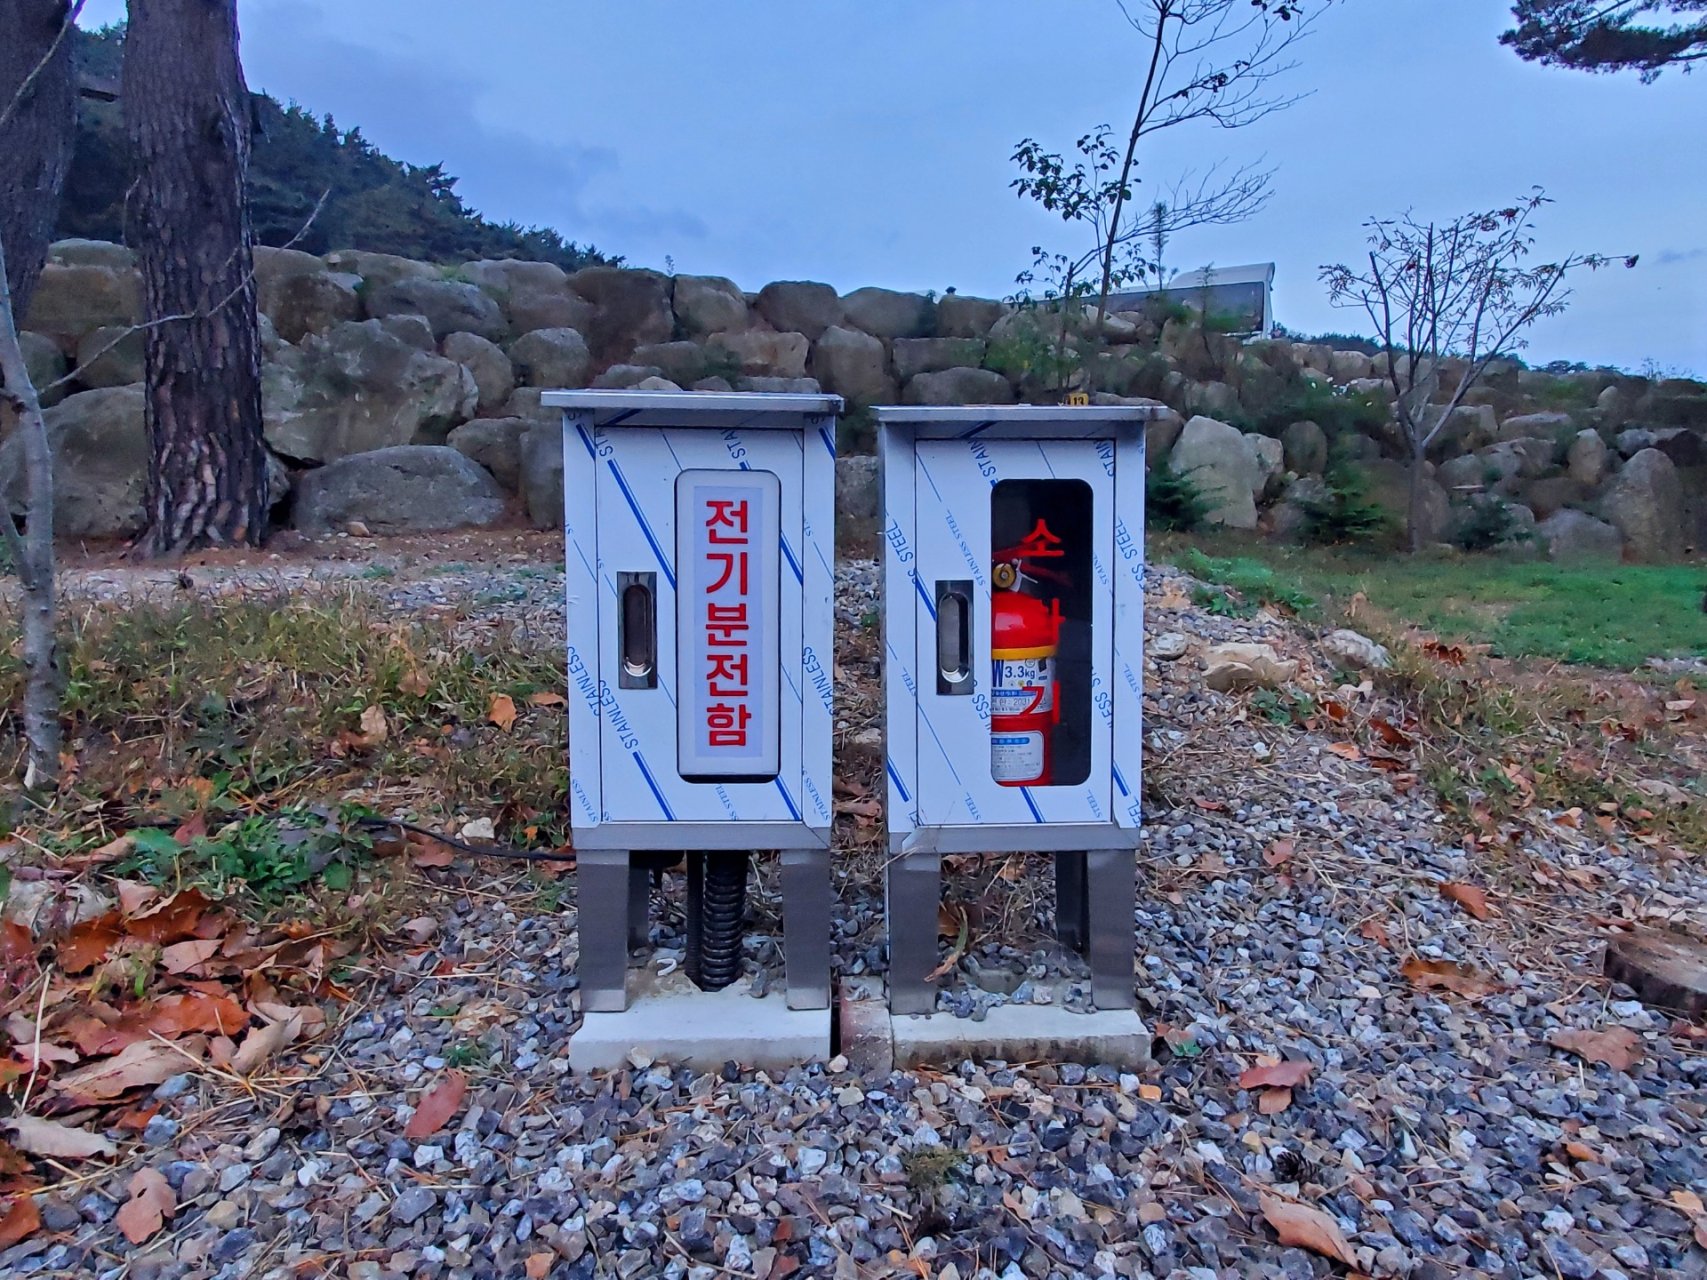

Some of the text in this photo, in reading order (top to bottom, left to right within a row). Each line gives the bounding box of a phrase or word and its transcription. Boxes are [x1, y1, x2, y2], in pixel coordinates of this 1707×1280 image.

[885, 517, 914, 563] STEEL
[1115, 515, 1138, 560] STEEL
[706, 500, 752, 746] 전기분전함
[1005, 665, 1036, 680] 3.3kg
[599, 679, 639, 750] STAINLESS
[964, 791, 982, 821] STEEL
[1086, 789, 1103, 819] STEEL
